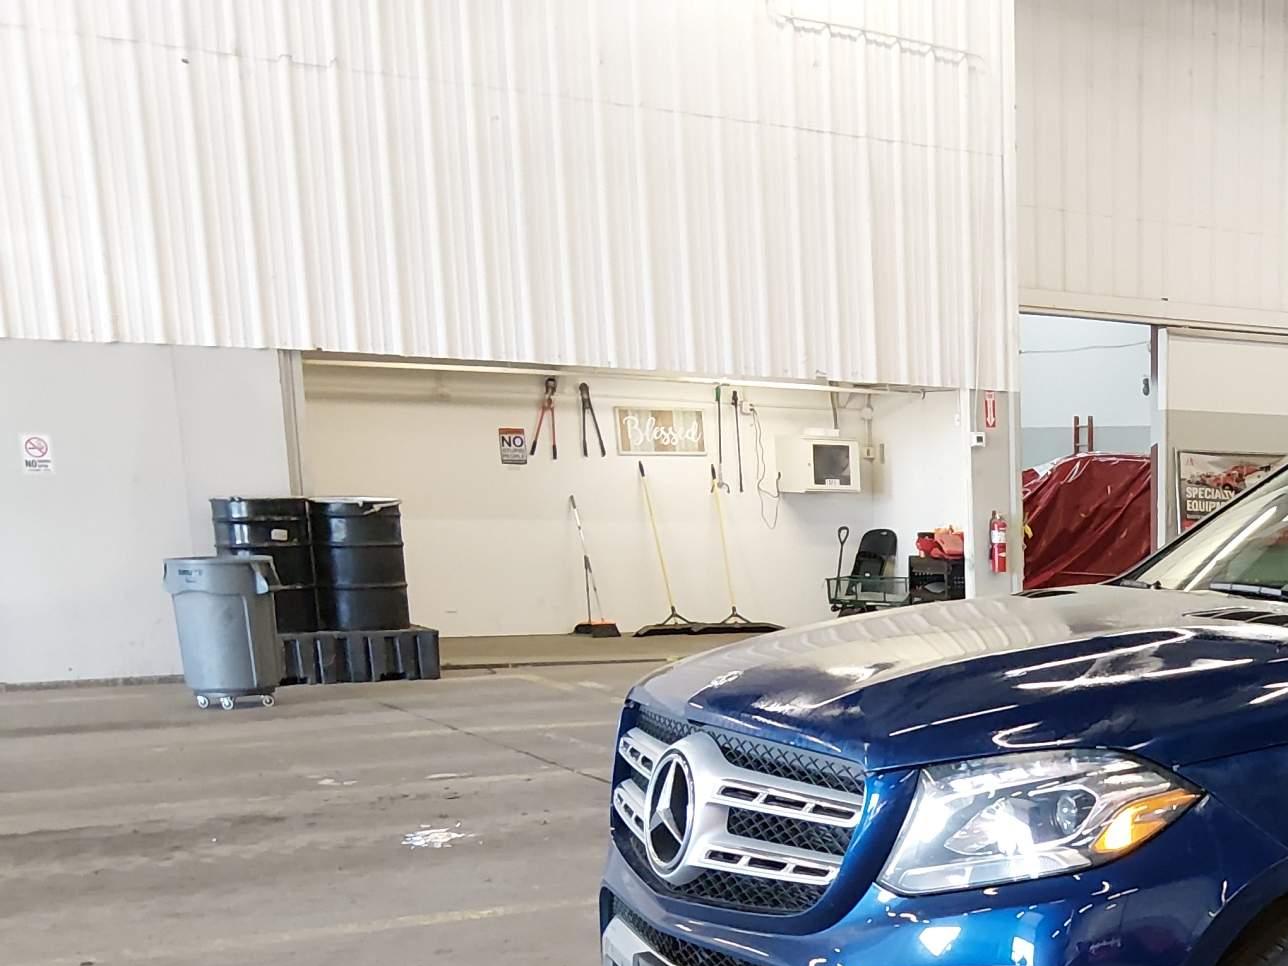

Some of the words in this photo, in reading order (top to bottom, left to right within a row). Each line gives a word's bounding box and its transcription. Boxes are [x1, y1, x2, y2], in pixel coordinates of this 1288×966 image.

[622, 415, 703, 446] Blessed
[501, 435, 524, 448] NO
[25, 459, 38, 468] NO
[1186, 487, 1236, 499] SPECIALTY
